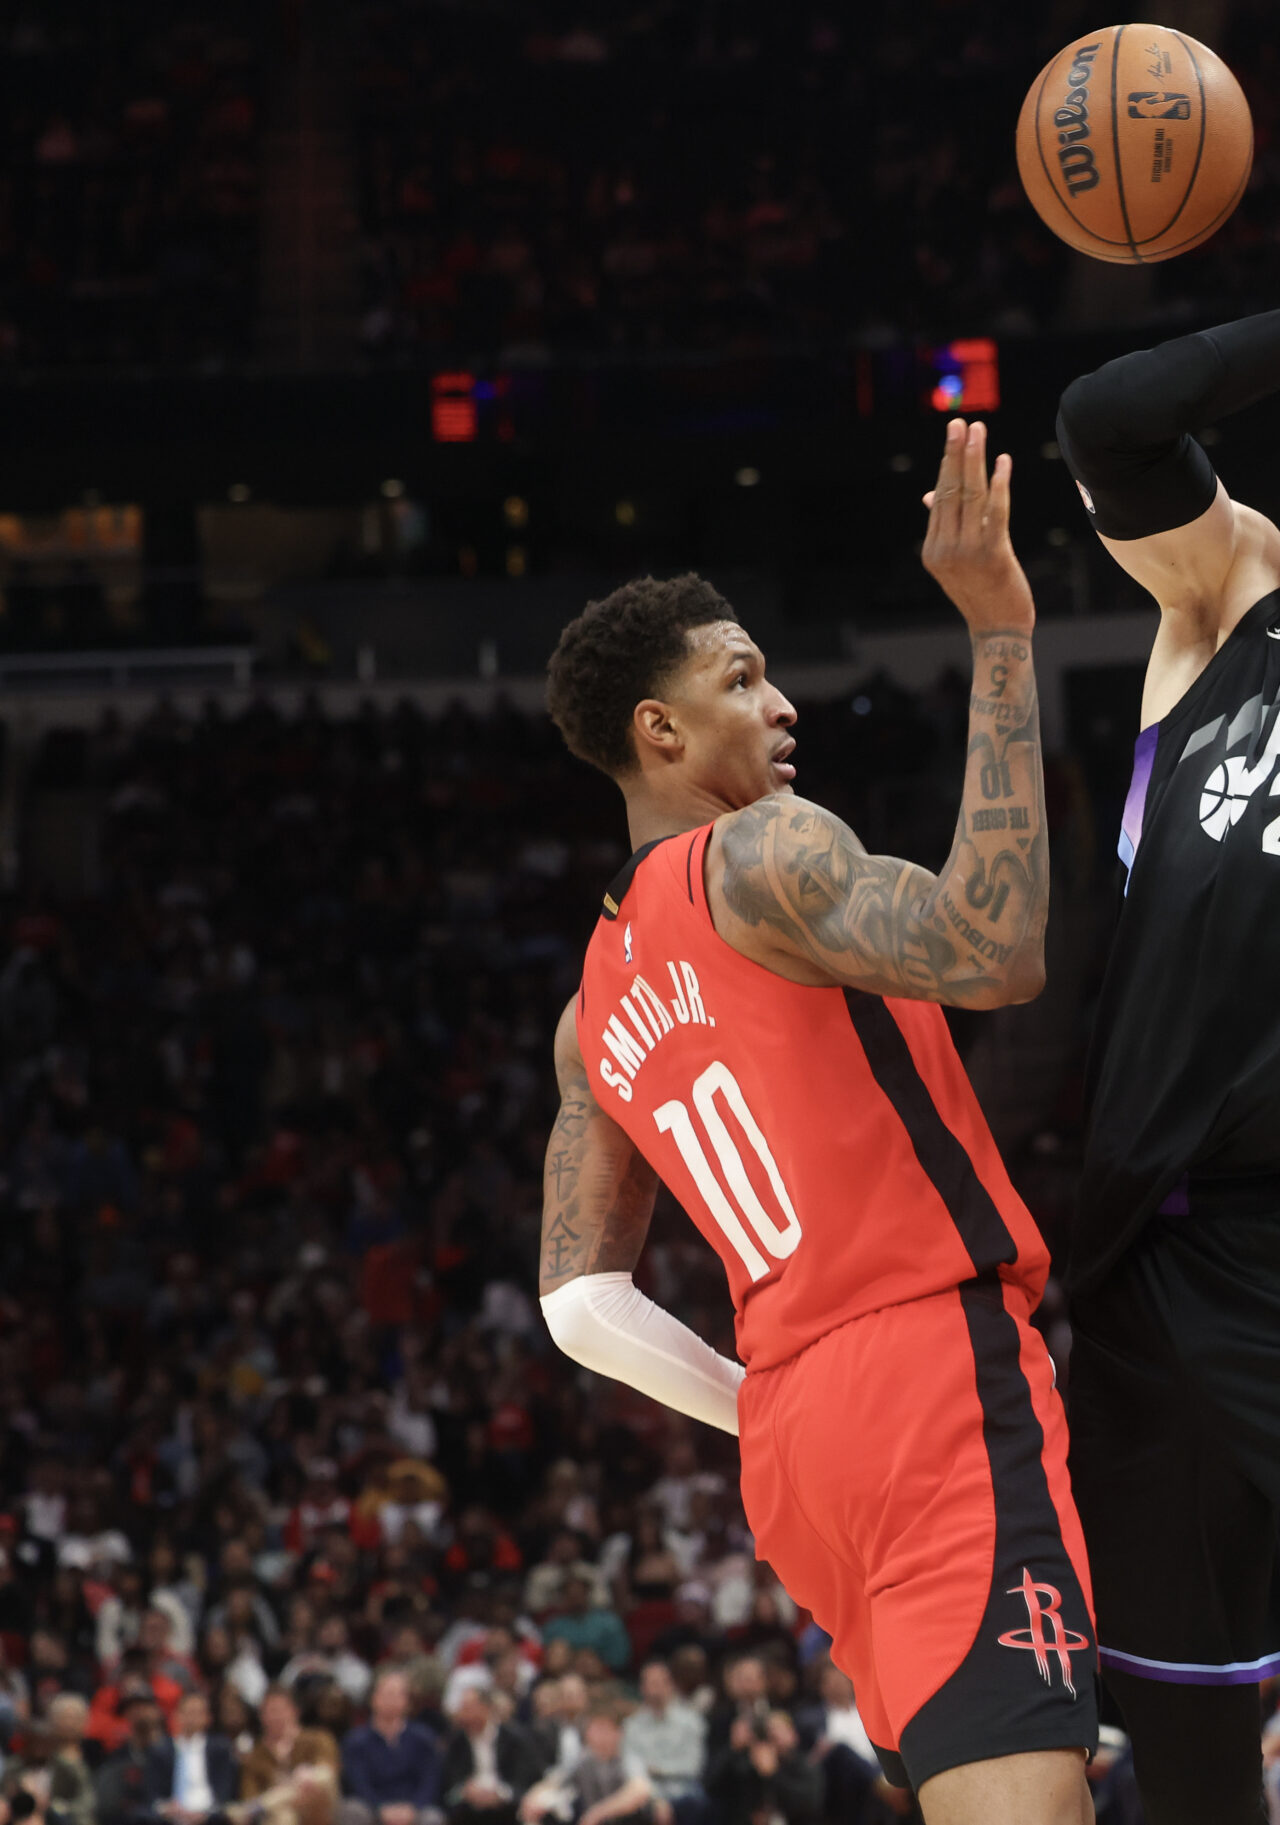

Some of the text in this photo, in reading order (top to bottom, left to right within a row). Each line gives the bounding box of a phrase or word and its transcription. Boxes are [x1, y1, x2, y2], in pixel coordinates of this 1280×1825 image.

[1054, 43, 1103, 198] Wilson
[988, 665, 1008, 697] 5
[980, 758, 1015, 800] 10
[942, 891, 1014, 964] AUBURN
[666, 960, 716, 1027] JR.
[652, 1060, 802, 1282] 10
